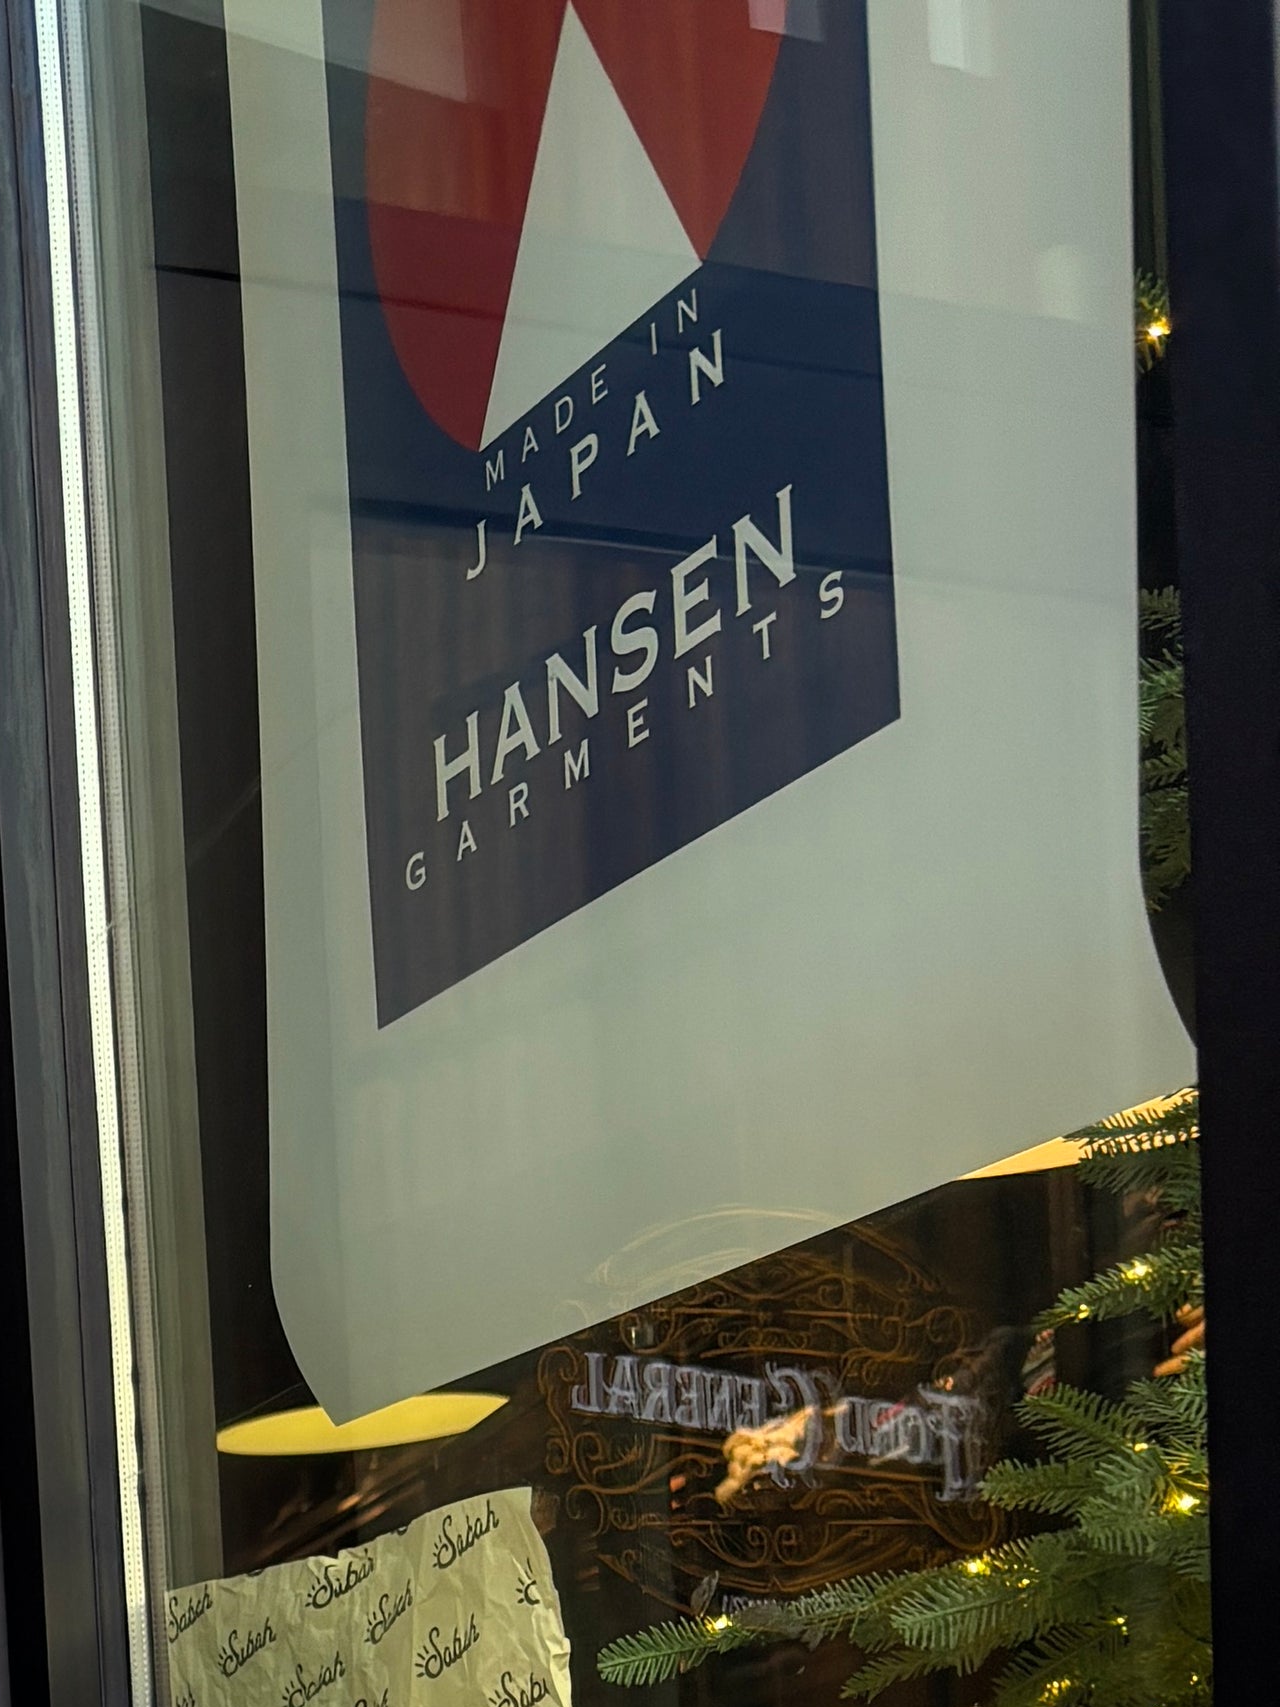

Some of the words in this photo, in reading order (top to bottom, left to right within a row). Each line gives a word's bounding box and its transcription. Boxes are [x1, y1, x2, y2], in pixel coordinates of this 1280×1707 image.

[465, 328, 724, 582] JAPAN
[486, 362, 608, 492] MADE
[650, 287, 700, 356] IN
[404, 570, 844, 892] GARMENTS
[432, 483, 797, 823] HANSEN
